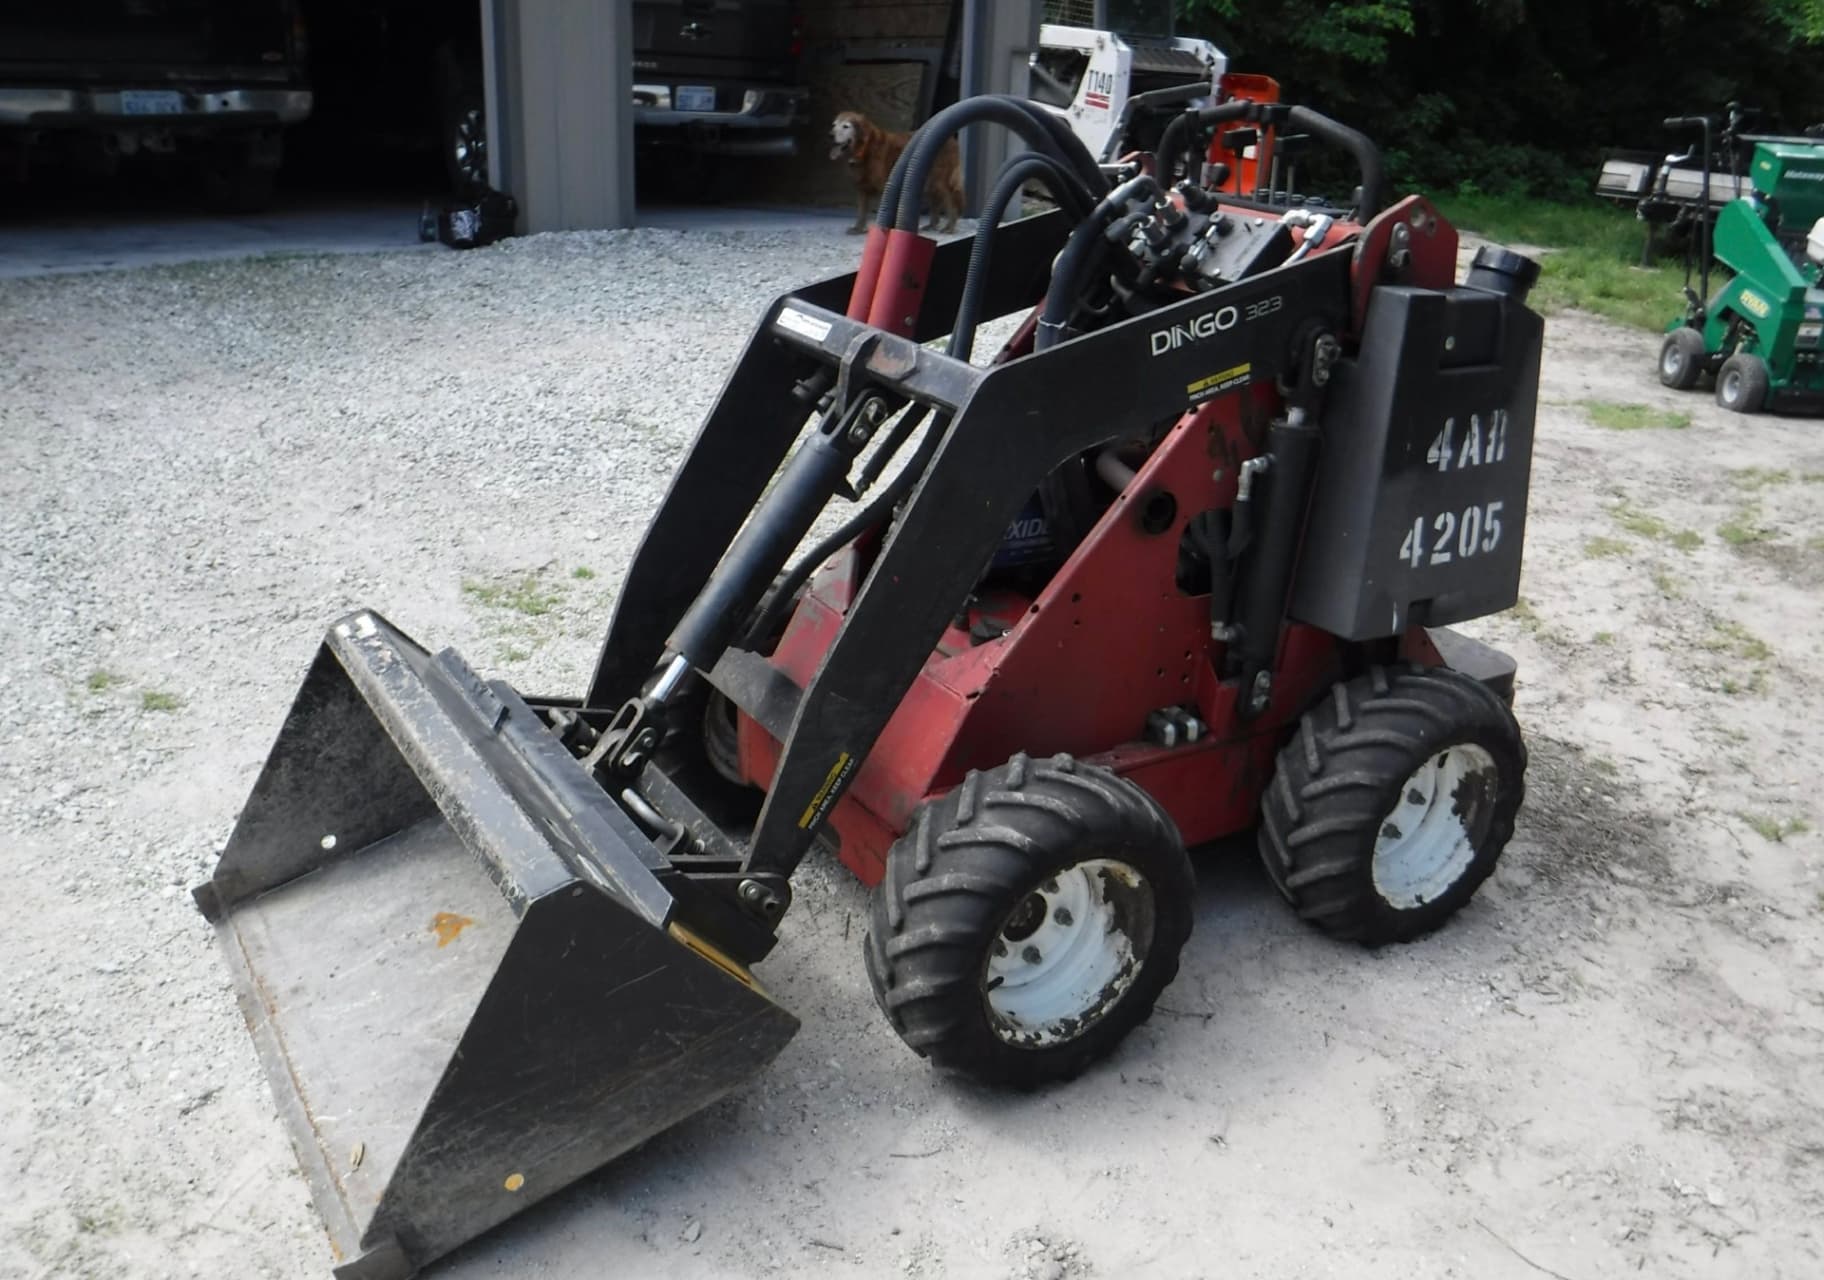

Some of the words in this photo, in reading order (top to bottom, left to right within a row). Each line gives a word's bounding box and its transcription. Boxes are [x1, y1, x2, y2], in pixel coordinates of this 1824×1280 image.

[1087, 69, 1113, 95] T140
[1150, 305, 1238, 357] DINGO
[1245, 295, 1283, 321] 323
[1399, 501, 1503, 569] 4205
